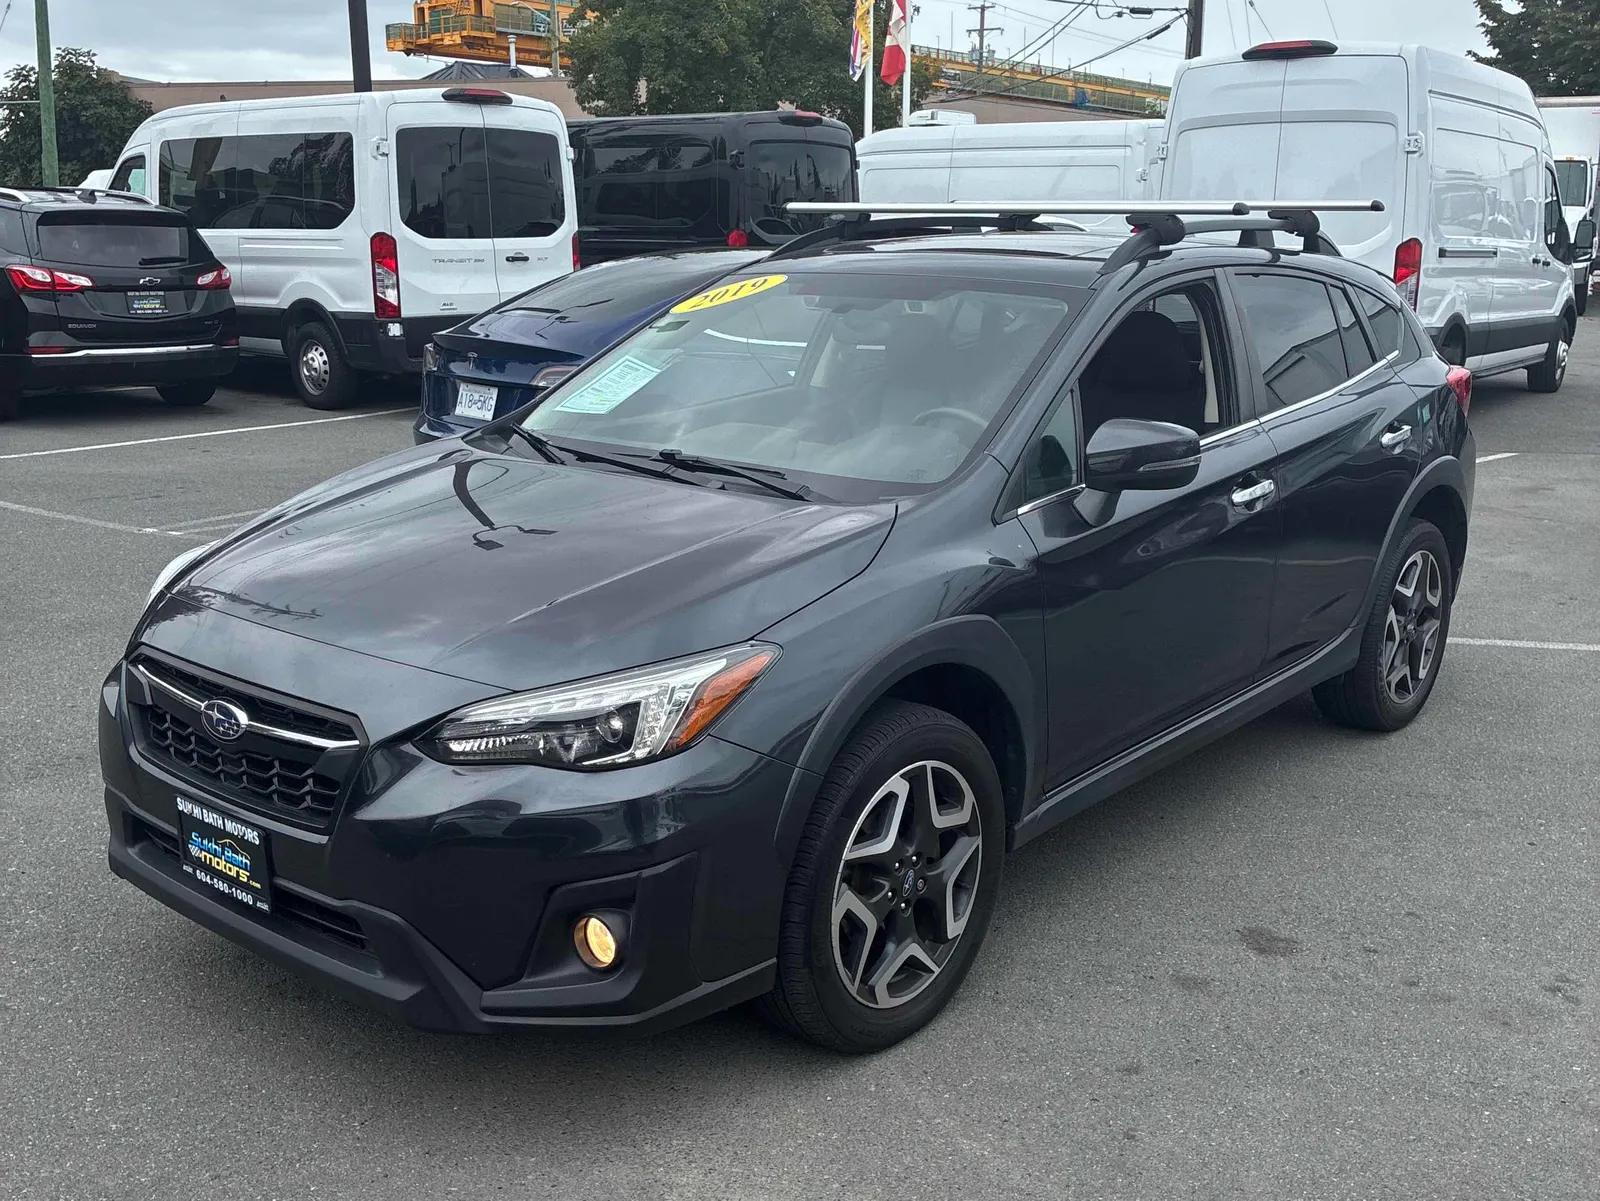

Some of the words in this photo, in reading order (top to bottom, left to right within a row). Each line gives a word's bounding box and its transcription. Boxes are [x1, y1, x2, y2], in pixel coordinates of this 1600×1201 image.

[688, 278, 768, 309] 2019
[176, 797, 202, 820] SUKHI
[202, 808, 223, 830] BATH
[224, 818, 260, 845] MOTORS
[189, 831, 222, 857] Sukhi
[224, 846, 251, 871] Bath
[196, 869, 253, 905] 604-580-1000
